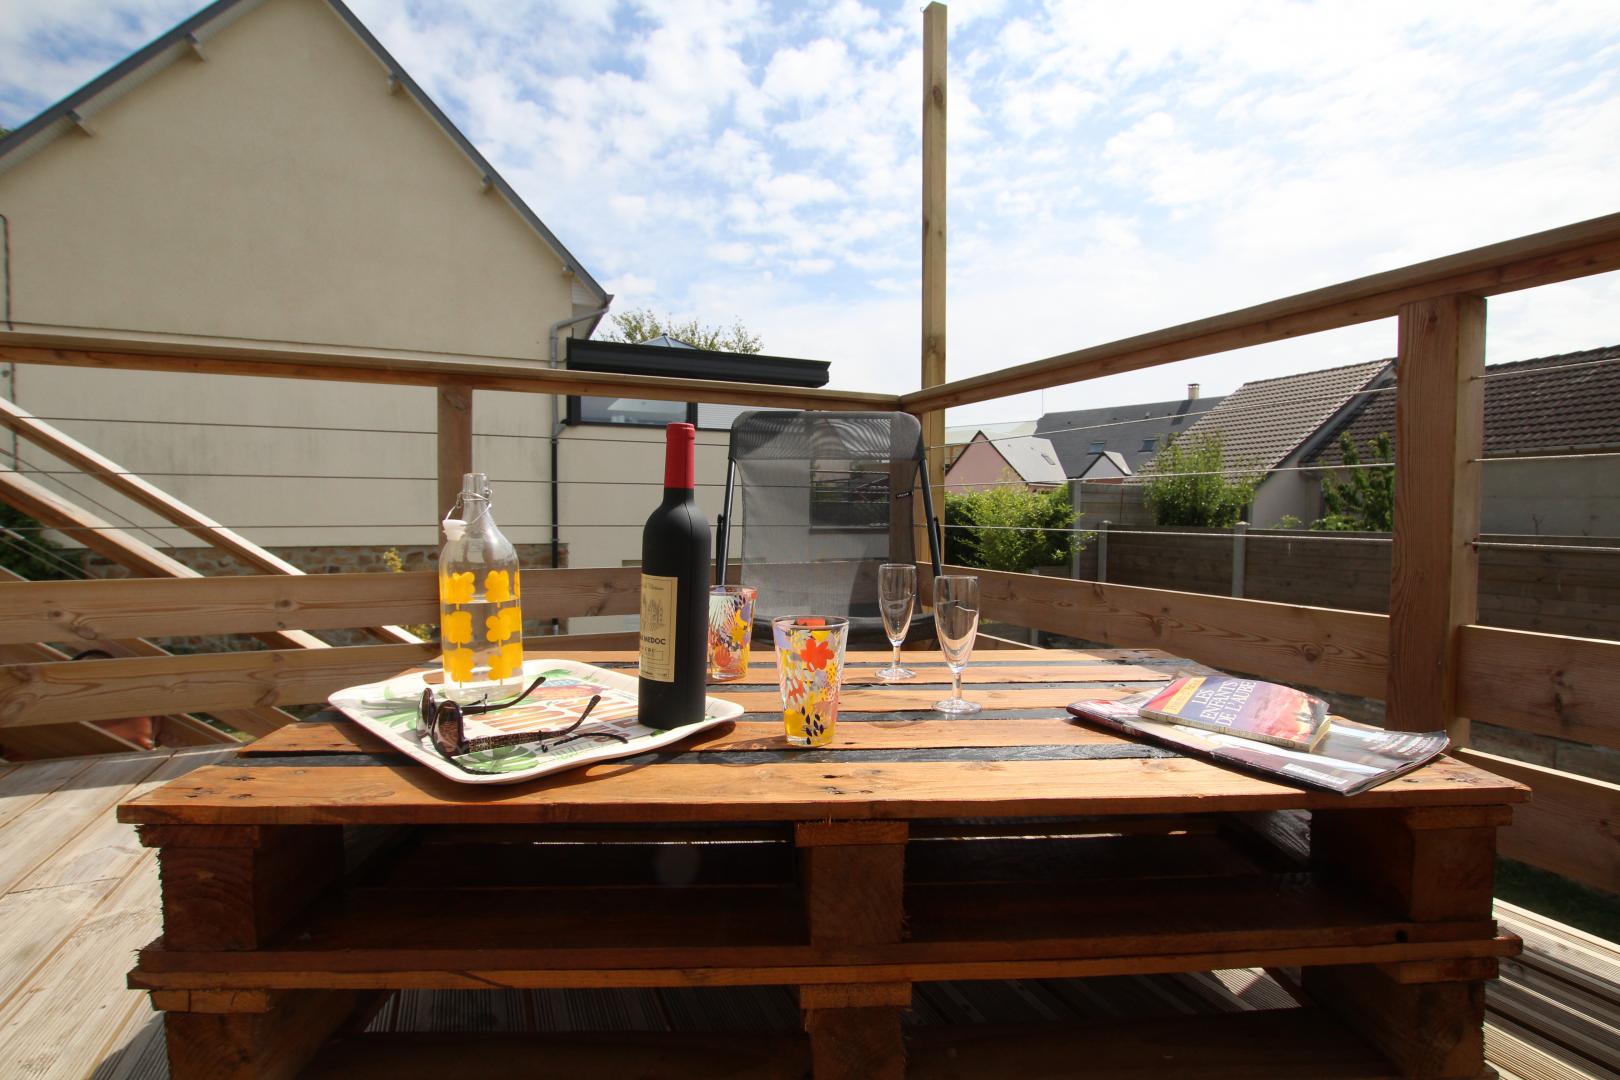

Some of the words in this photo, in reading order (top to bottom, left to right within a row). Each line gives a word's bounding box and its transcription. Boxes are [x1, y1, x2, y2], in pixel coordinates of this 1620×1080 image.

[1192, 689, 1214, 704] LES
[1200, 681, 1239, 720] ENFANTS
[1215, 714, 1236, 727] DE
